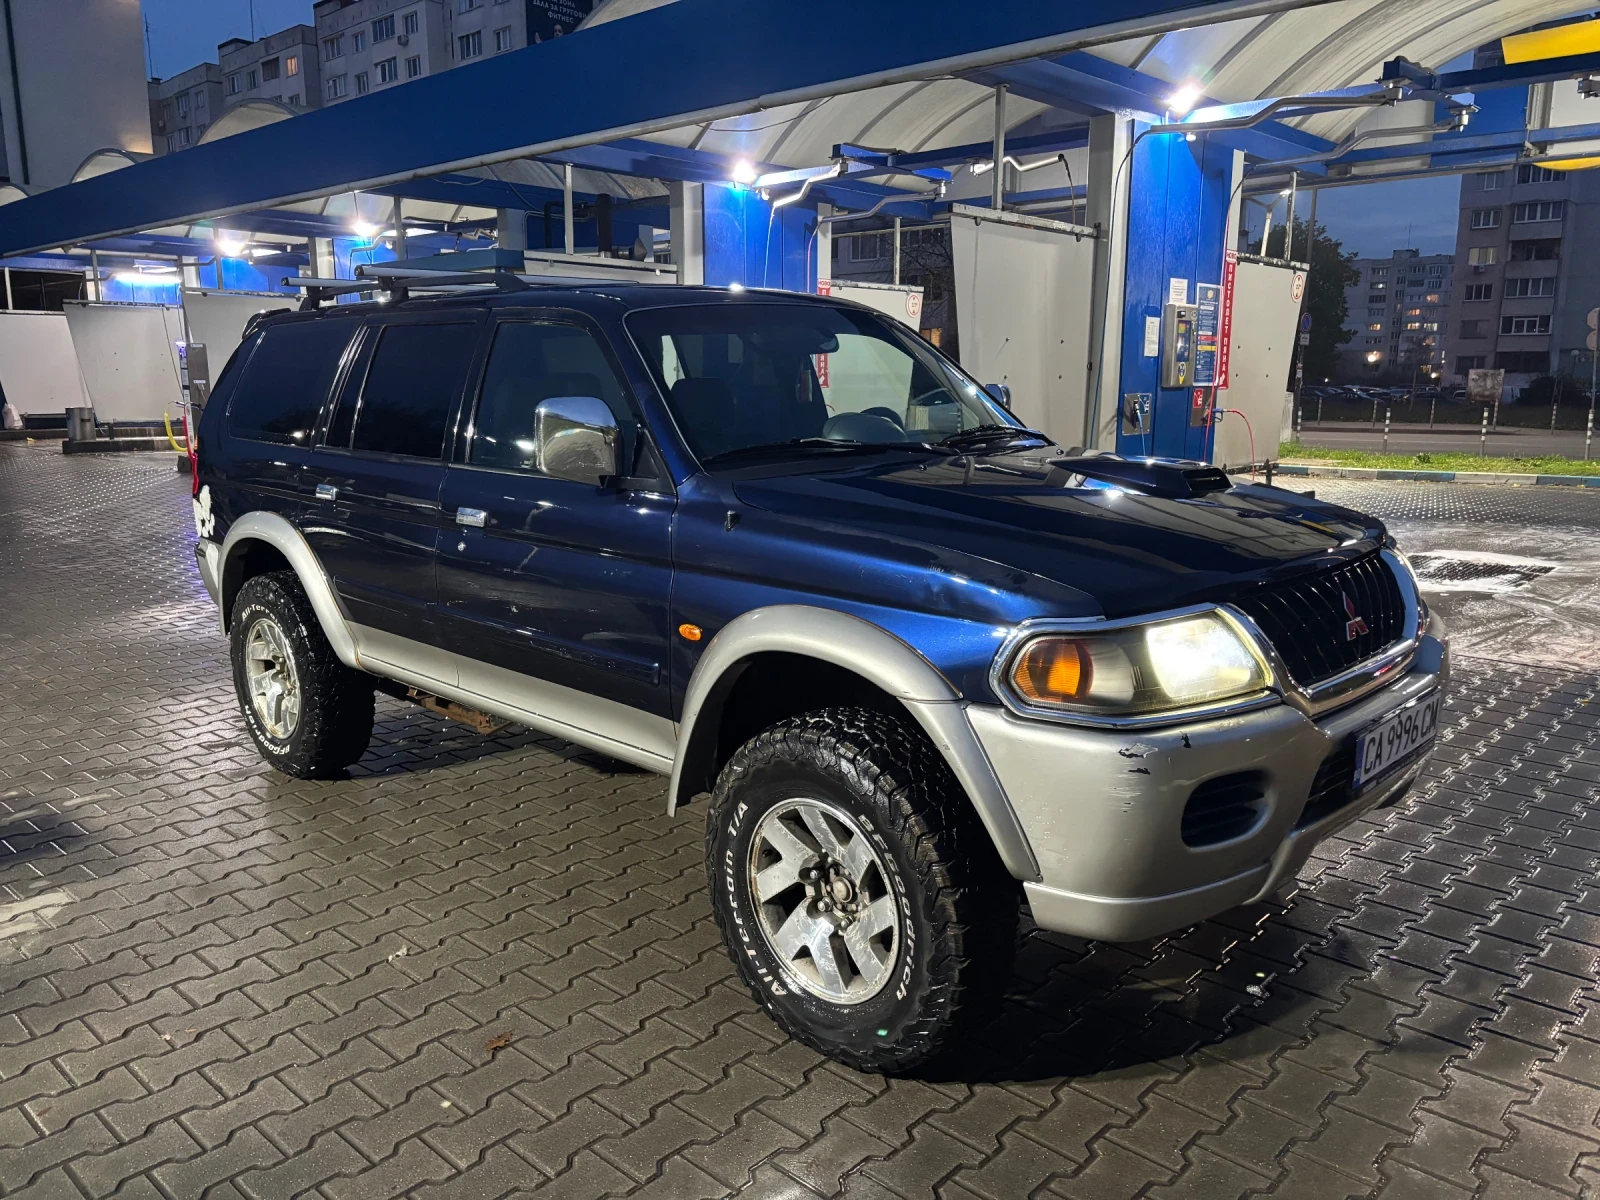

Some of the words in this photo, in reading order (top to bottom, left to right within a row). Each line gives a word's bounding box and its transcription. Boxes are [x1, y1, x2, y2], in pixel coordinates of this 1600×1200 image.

[547, 11, 574, 23] ФИТНЕС
[550, 3, 558, 11] ЗА
[1364, 732, 1383, 775] CA
[1386, 709, 1420, 761] 9996
[727, 800, 749, 838] T/A
[725, 849, 787, 997] All-Terrain
[858, 814, 917, 1001] BFGoodrich
